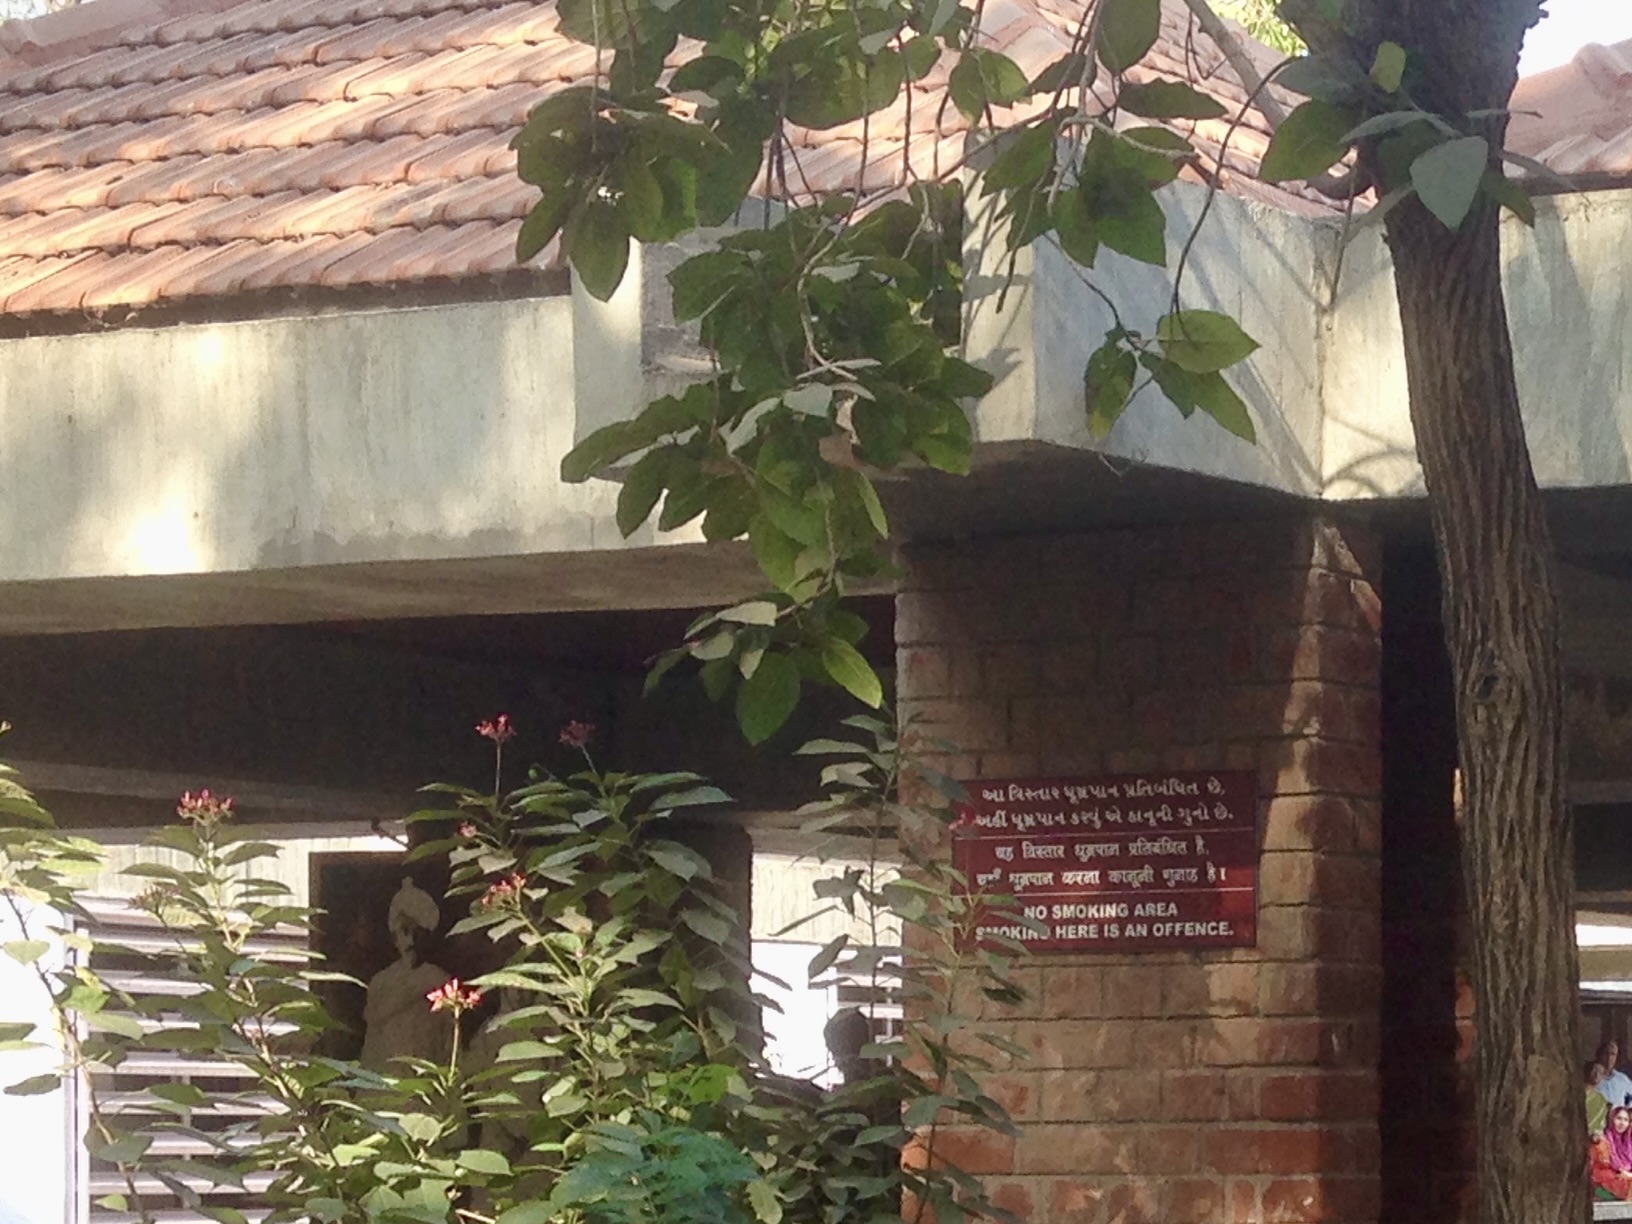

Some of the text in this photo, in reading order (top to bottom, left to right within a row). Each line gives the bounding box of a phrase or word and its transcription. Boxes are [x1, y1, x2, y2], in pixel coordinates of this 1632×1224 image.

[1023, 902, 1178, 919] NO SMOKING AREA
[1055, 924, 1098, 939] HERE
[1103, 924, 1119, 938] IS
[1124, 923, 1147, 937] AN
[1152, 921, 1234, 936] OFFENCE.
